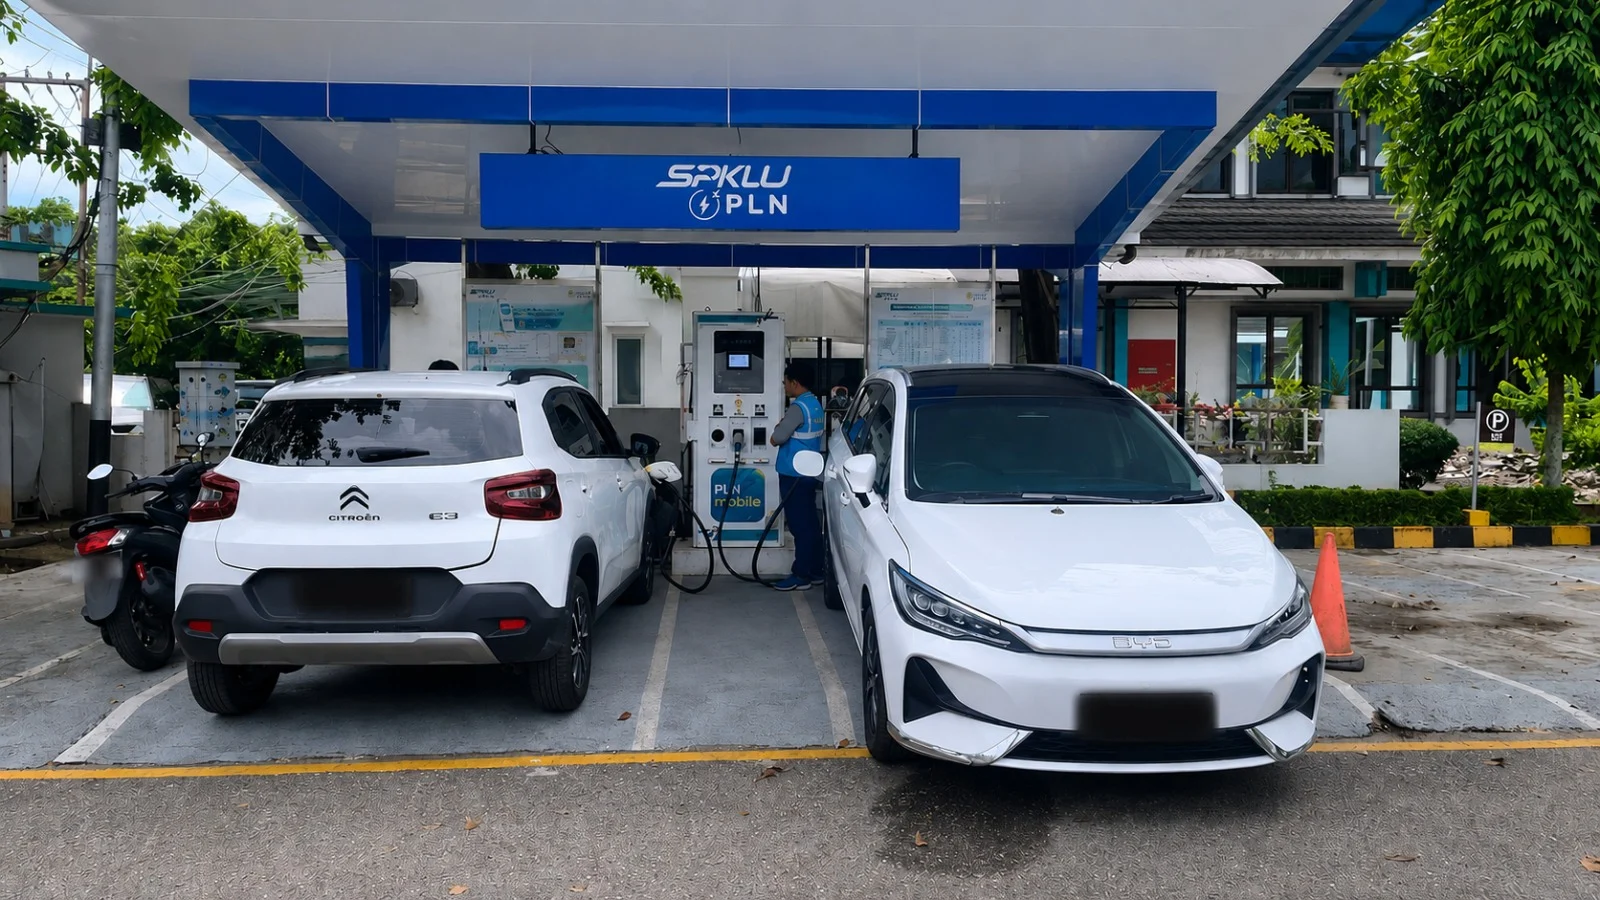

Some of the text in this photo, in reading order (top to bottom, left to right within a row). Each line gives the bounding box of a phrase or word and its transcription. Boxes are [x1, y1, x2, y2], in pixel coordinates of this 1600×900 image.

[655, 164, 792, 188] SPKLU
[726, 193, 788, 215] PLN
[1492, 413, 1504, 428] P
[714, 484, 741, 495] PLN
[714, 495, 761, 507] mobile
[1112, 636, 1172, 649] BYD
